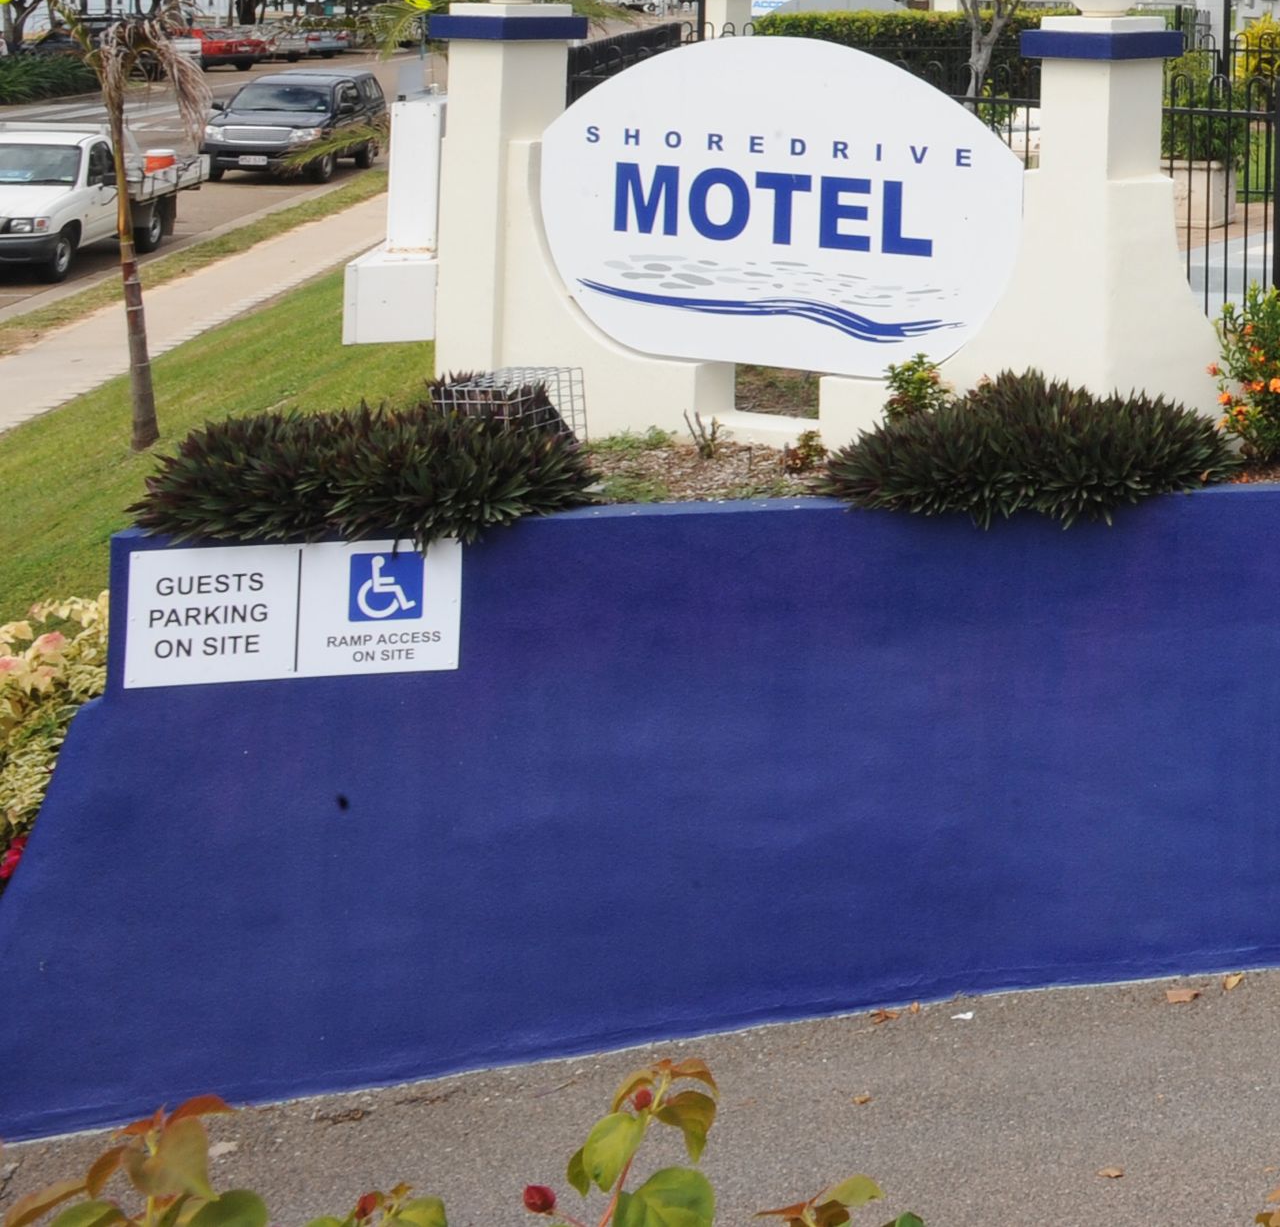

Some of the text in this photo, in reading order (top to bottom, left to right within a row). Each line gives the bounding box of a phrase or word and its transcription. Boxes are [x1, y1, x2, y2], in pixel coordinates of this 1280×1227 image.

[585, 125, 972, 167] SHOREDRIVE
[613, 161, 933, 257] MOTEL
[156, 572, 264, 597] GUESTS
[149, 603, 269, 628] PARKING
[154, 634, 261, 659] ON SITE
[326, 630, 442, 648] RAMP ACCESS
[352, 648, 415, 663] ON SITE
